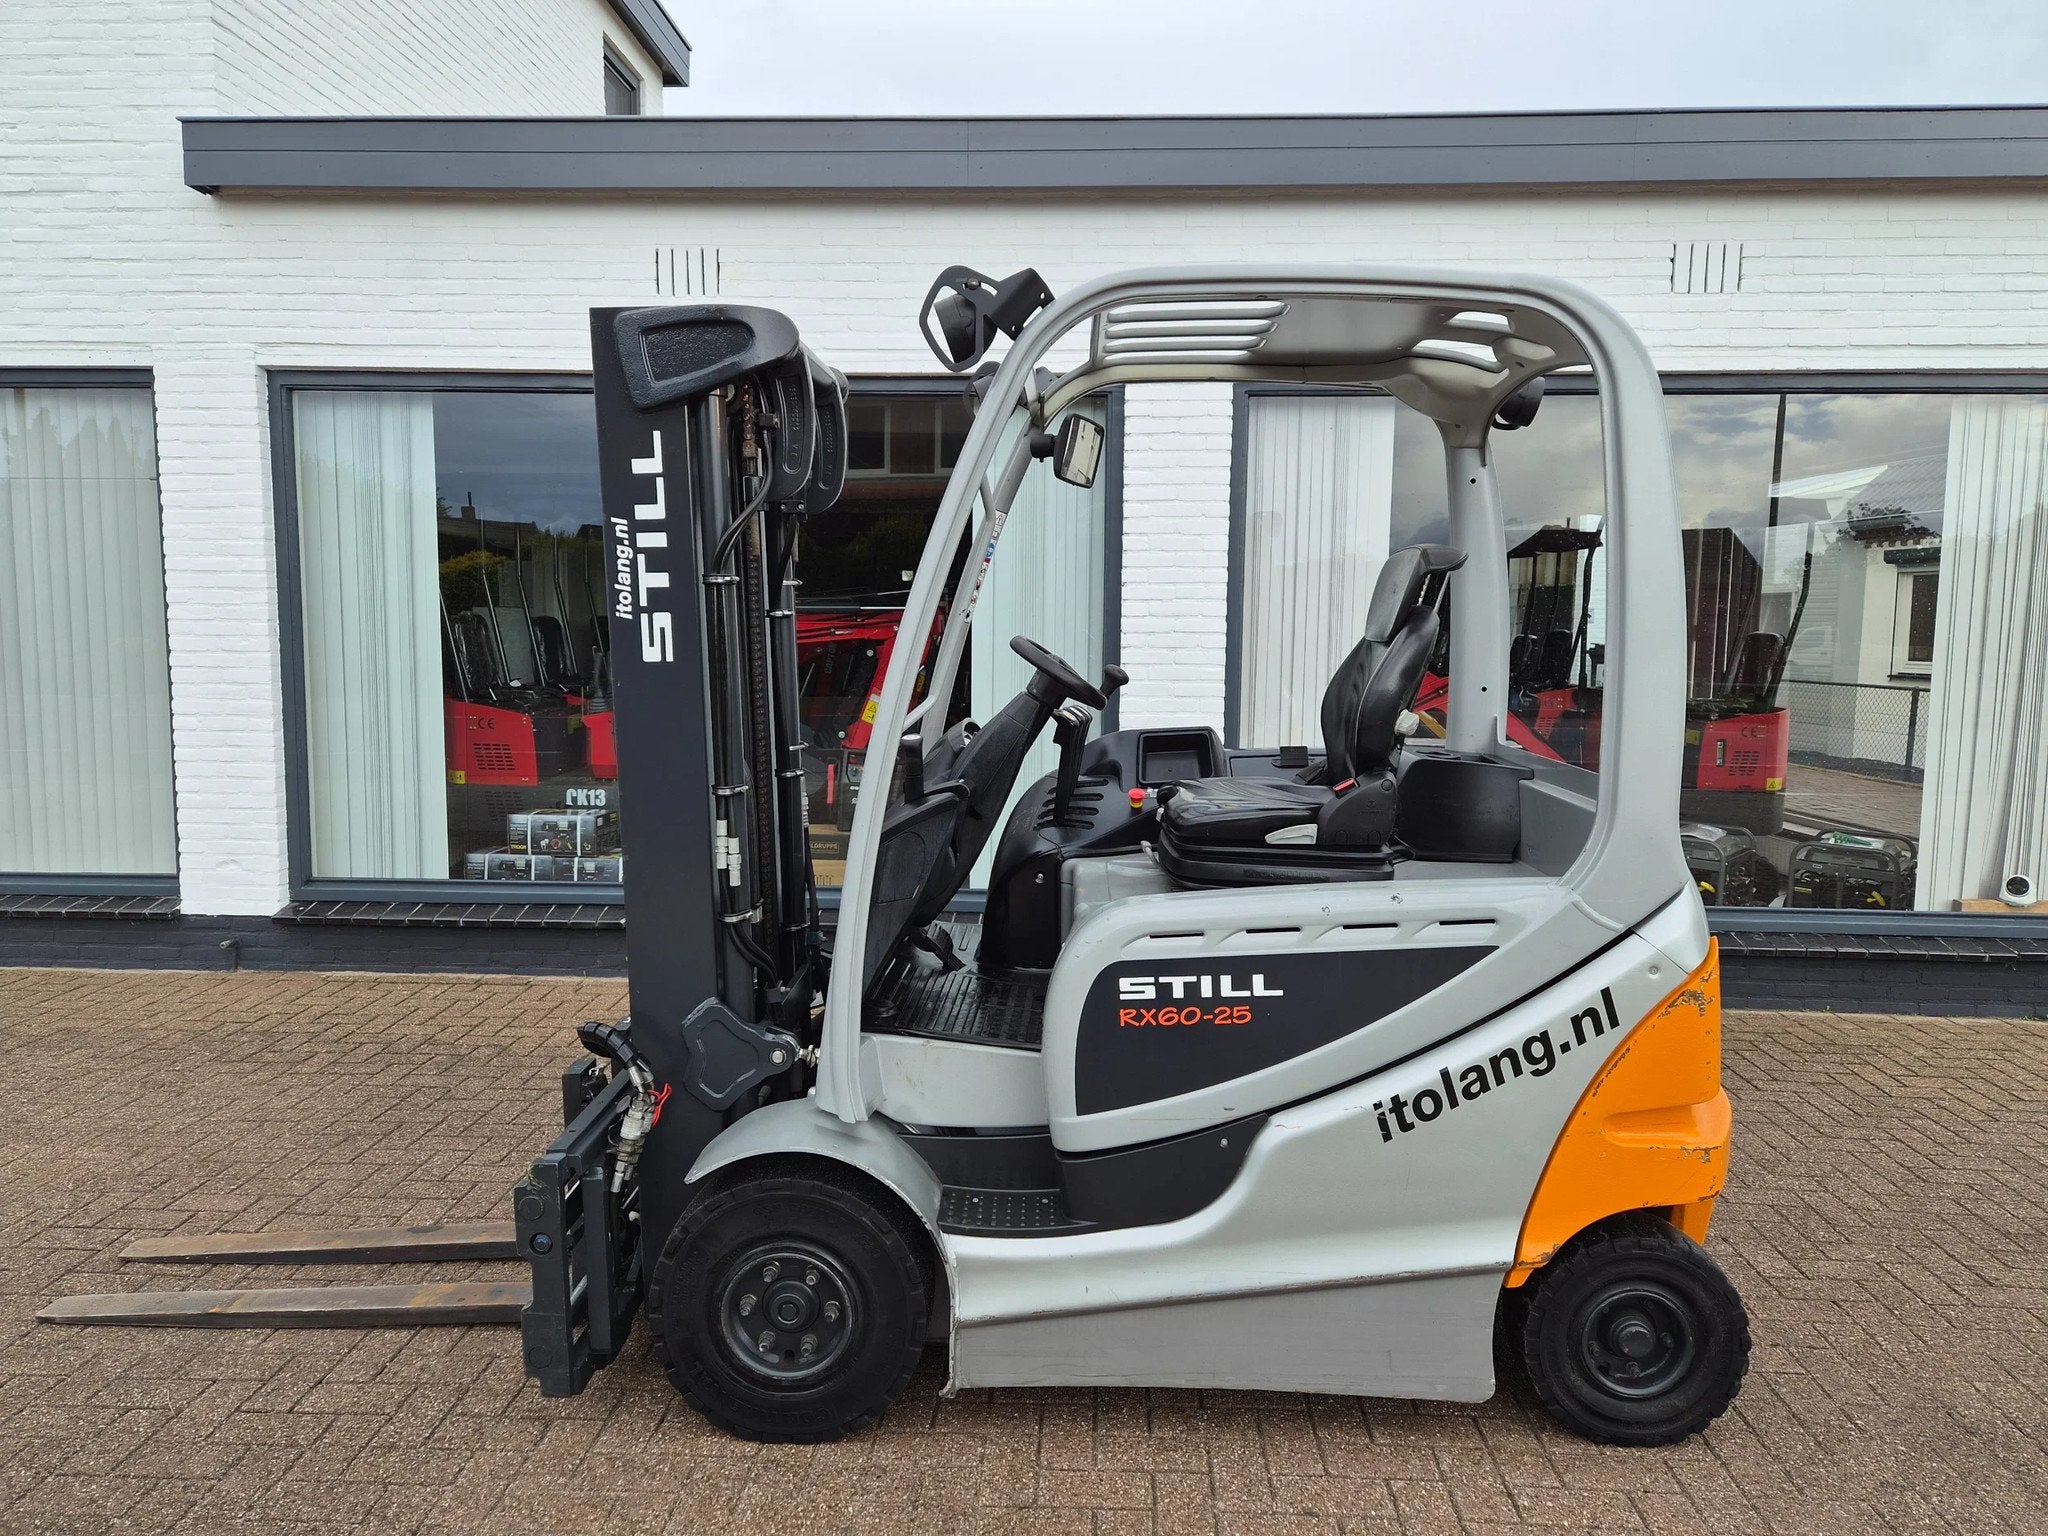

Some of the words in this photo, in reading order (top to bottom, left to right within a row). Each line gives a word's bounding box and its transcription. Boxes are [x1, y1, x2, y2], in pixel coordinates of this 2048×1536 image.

[610, 517, 633, 620] itolang.nl
[631, 430, 673, 662] STILL
[1119, 974, 1284, 1000] STILL
[1119, 1006, 1252, 1028] RX60-25
[1372, 987, 1620, 1144] itolang.nl
